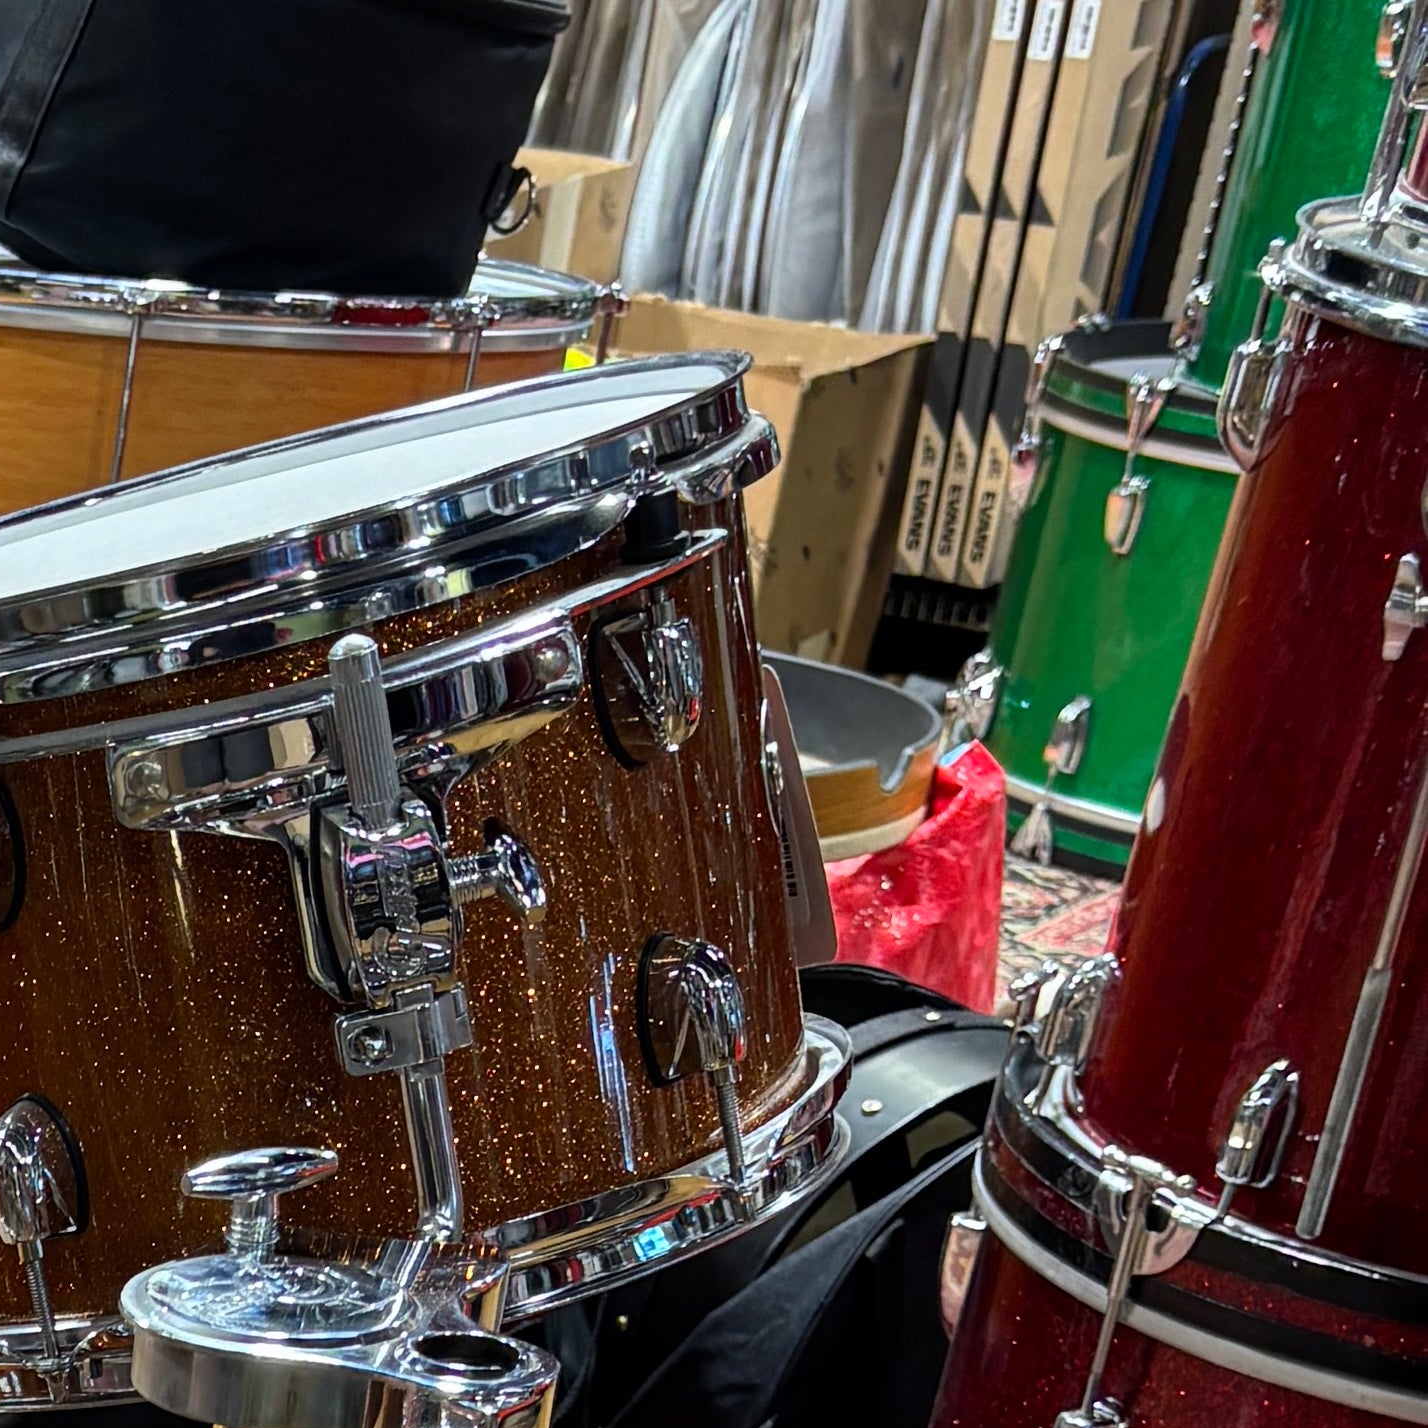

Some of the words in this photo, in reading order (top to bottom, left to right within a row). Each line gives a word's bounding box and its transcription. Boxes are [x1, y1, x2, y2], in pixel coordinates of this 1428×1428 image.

[906, 479, 932, 551] EVANS
[937, 484, 962, 557] EVANS
[970, 491, 996, 564] EVANS
